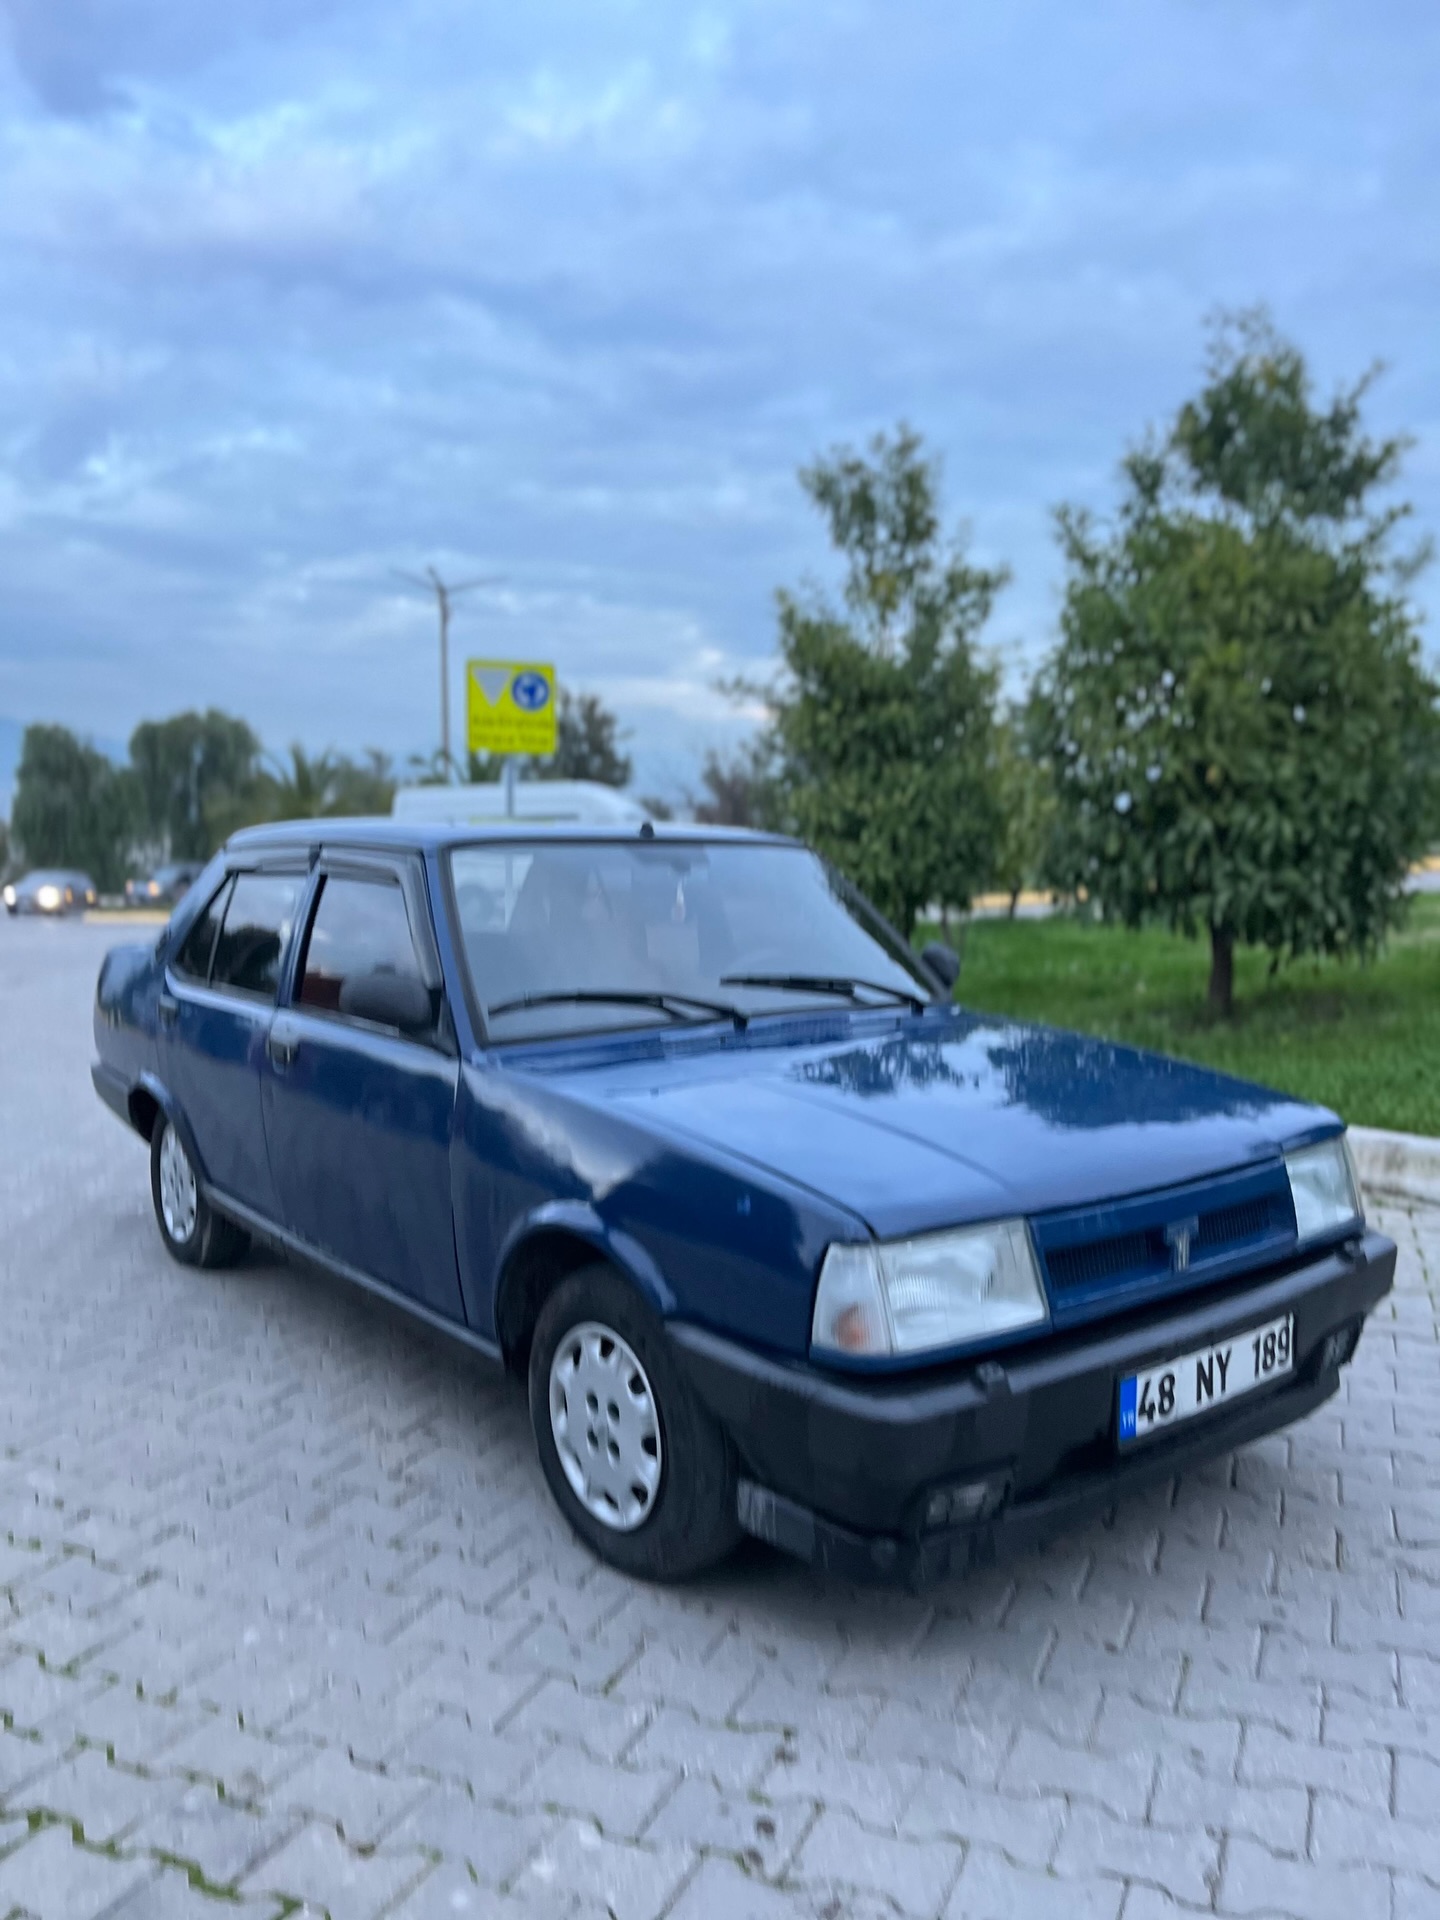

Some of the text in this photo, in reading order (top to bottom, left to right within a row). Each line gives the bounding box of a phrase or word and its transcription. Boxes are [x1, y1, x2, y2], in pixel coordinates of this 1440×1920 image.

[1138, 1373, 1176, 1423] 48
[1196, 1349, 1232, 1404] NY
[1253, 1323, 1292, 1377] 189
